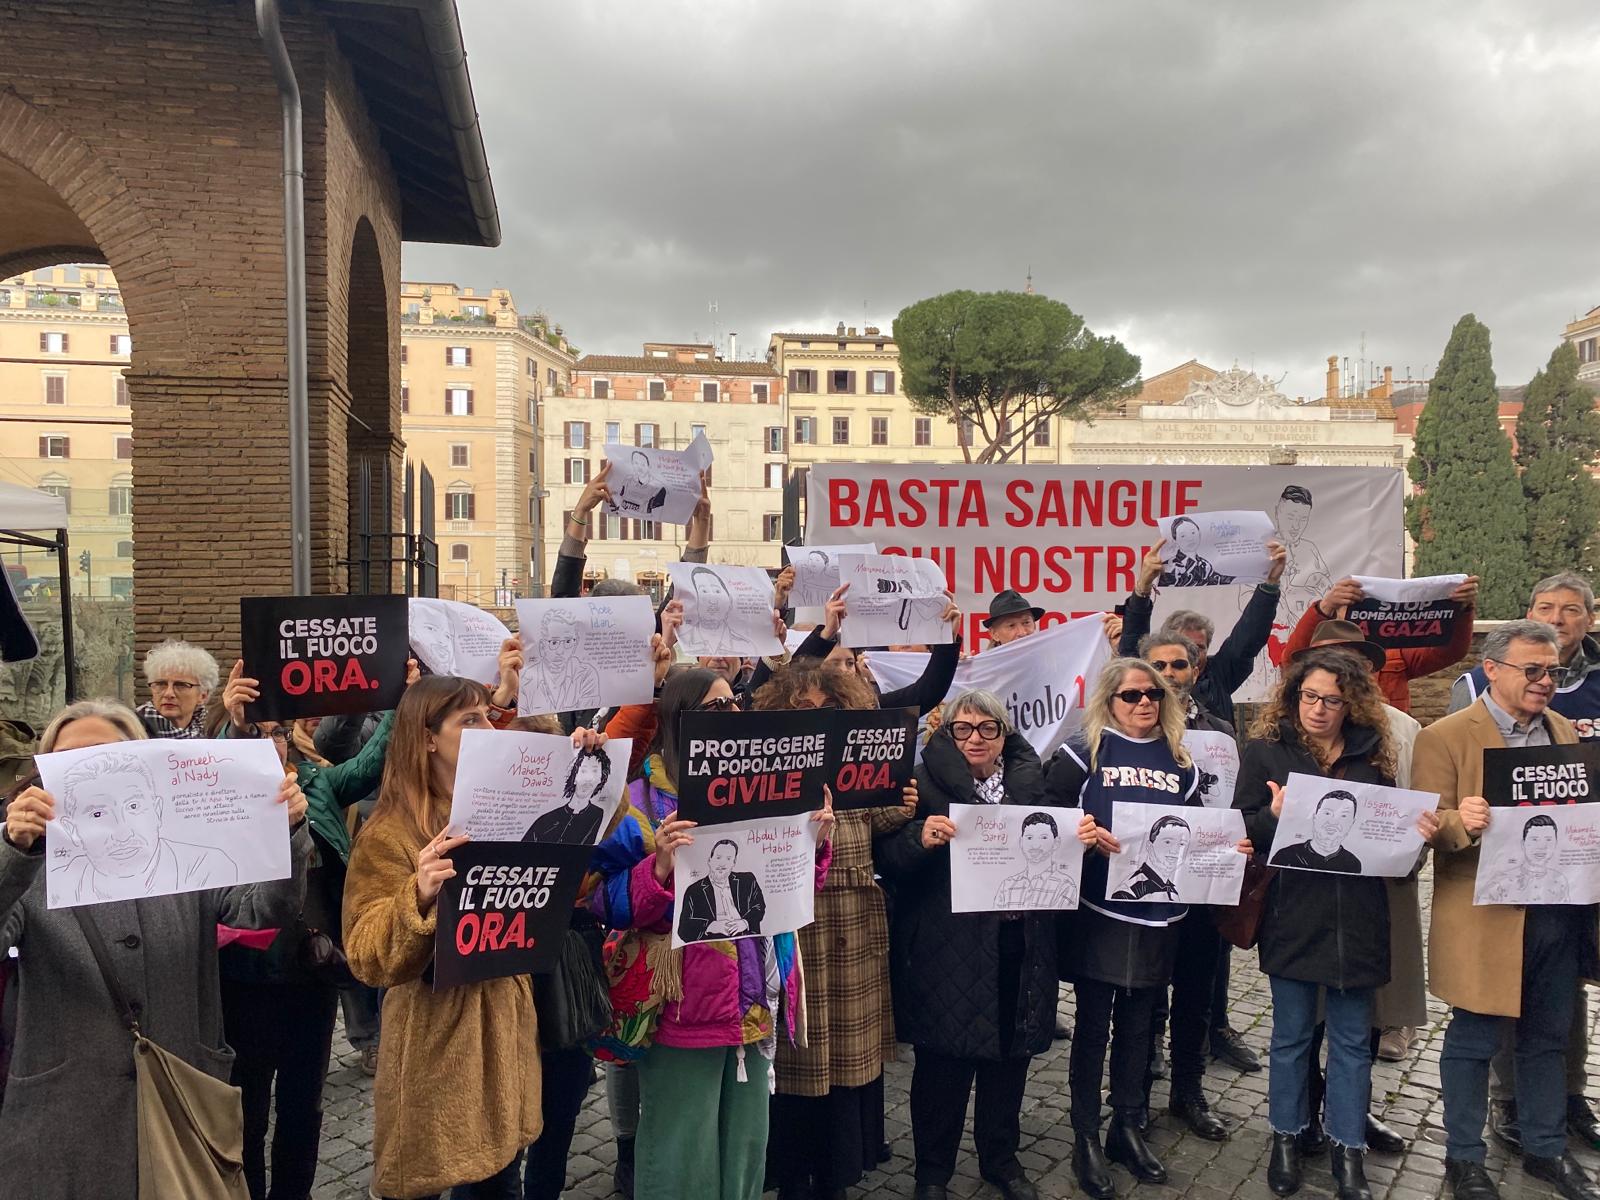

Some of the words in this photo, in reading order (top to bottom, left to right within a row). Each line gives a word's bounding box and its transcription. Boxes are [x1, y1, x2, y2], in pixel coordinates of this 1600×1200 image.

[1156, 424, 1180, 432] ALLE
[1192, 424, 1218, 432] ARTI
[828, 478, 990, 528] BASTA
[1005, 480, 1203, 528] SANGUE
[974, 546, 1151, 594] NOSTR
[1350, 610, 1454, 621] BOMBARDAMENTI
[280, 617, 377, 638] CESSATE
[1378, 620, 1442, 637] GAZA
[280, 639, 299, 659] IL
[307, 635, 378, 658] FUOCO
[281, 658, 379, 695] ORA.
[689, 733, 826, 758] PROTEGGERE
[847, 727, 906, 744] CESSATE
[168, 752, 234, 770] Sameeh
[518, 746, 553, 770] Yousef
[842, 745, 854, 762] IL
[859, 743, 904, 761] FUOCO
[688, 760, 712, 776] LA
[718, 751, 825, 775] POPOLAZIONE
[1512, 762, 1587, 782] CESSATE
[171, 772, 180, 785] al
[185, 768, 219, 786] Nady
[522, 777, 553, 788] Dawas
[836, 762, 896, 792] ORA.
[1101, 766, 1180, 794] PRESS
[707, 771, 803, 807] CIVILE
[1512, 783, 1528, 800] IL
[1534, 779, 1589, 799] FUOCO
[747, 826, 777, 844] Abdul
[466, 865, 560, 886] CESSATE
[459, 887, 475, 910] IL
[482, 887, 550, 910] FUOCO
[455, 911, 535, 956] ORA.
